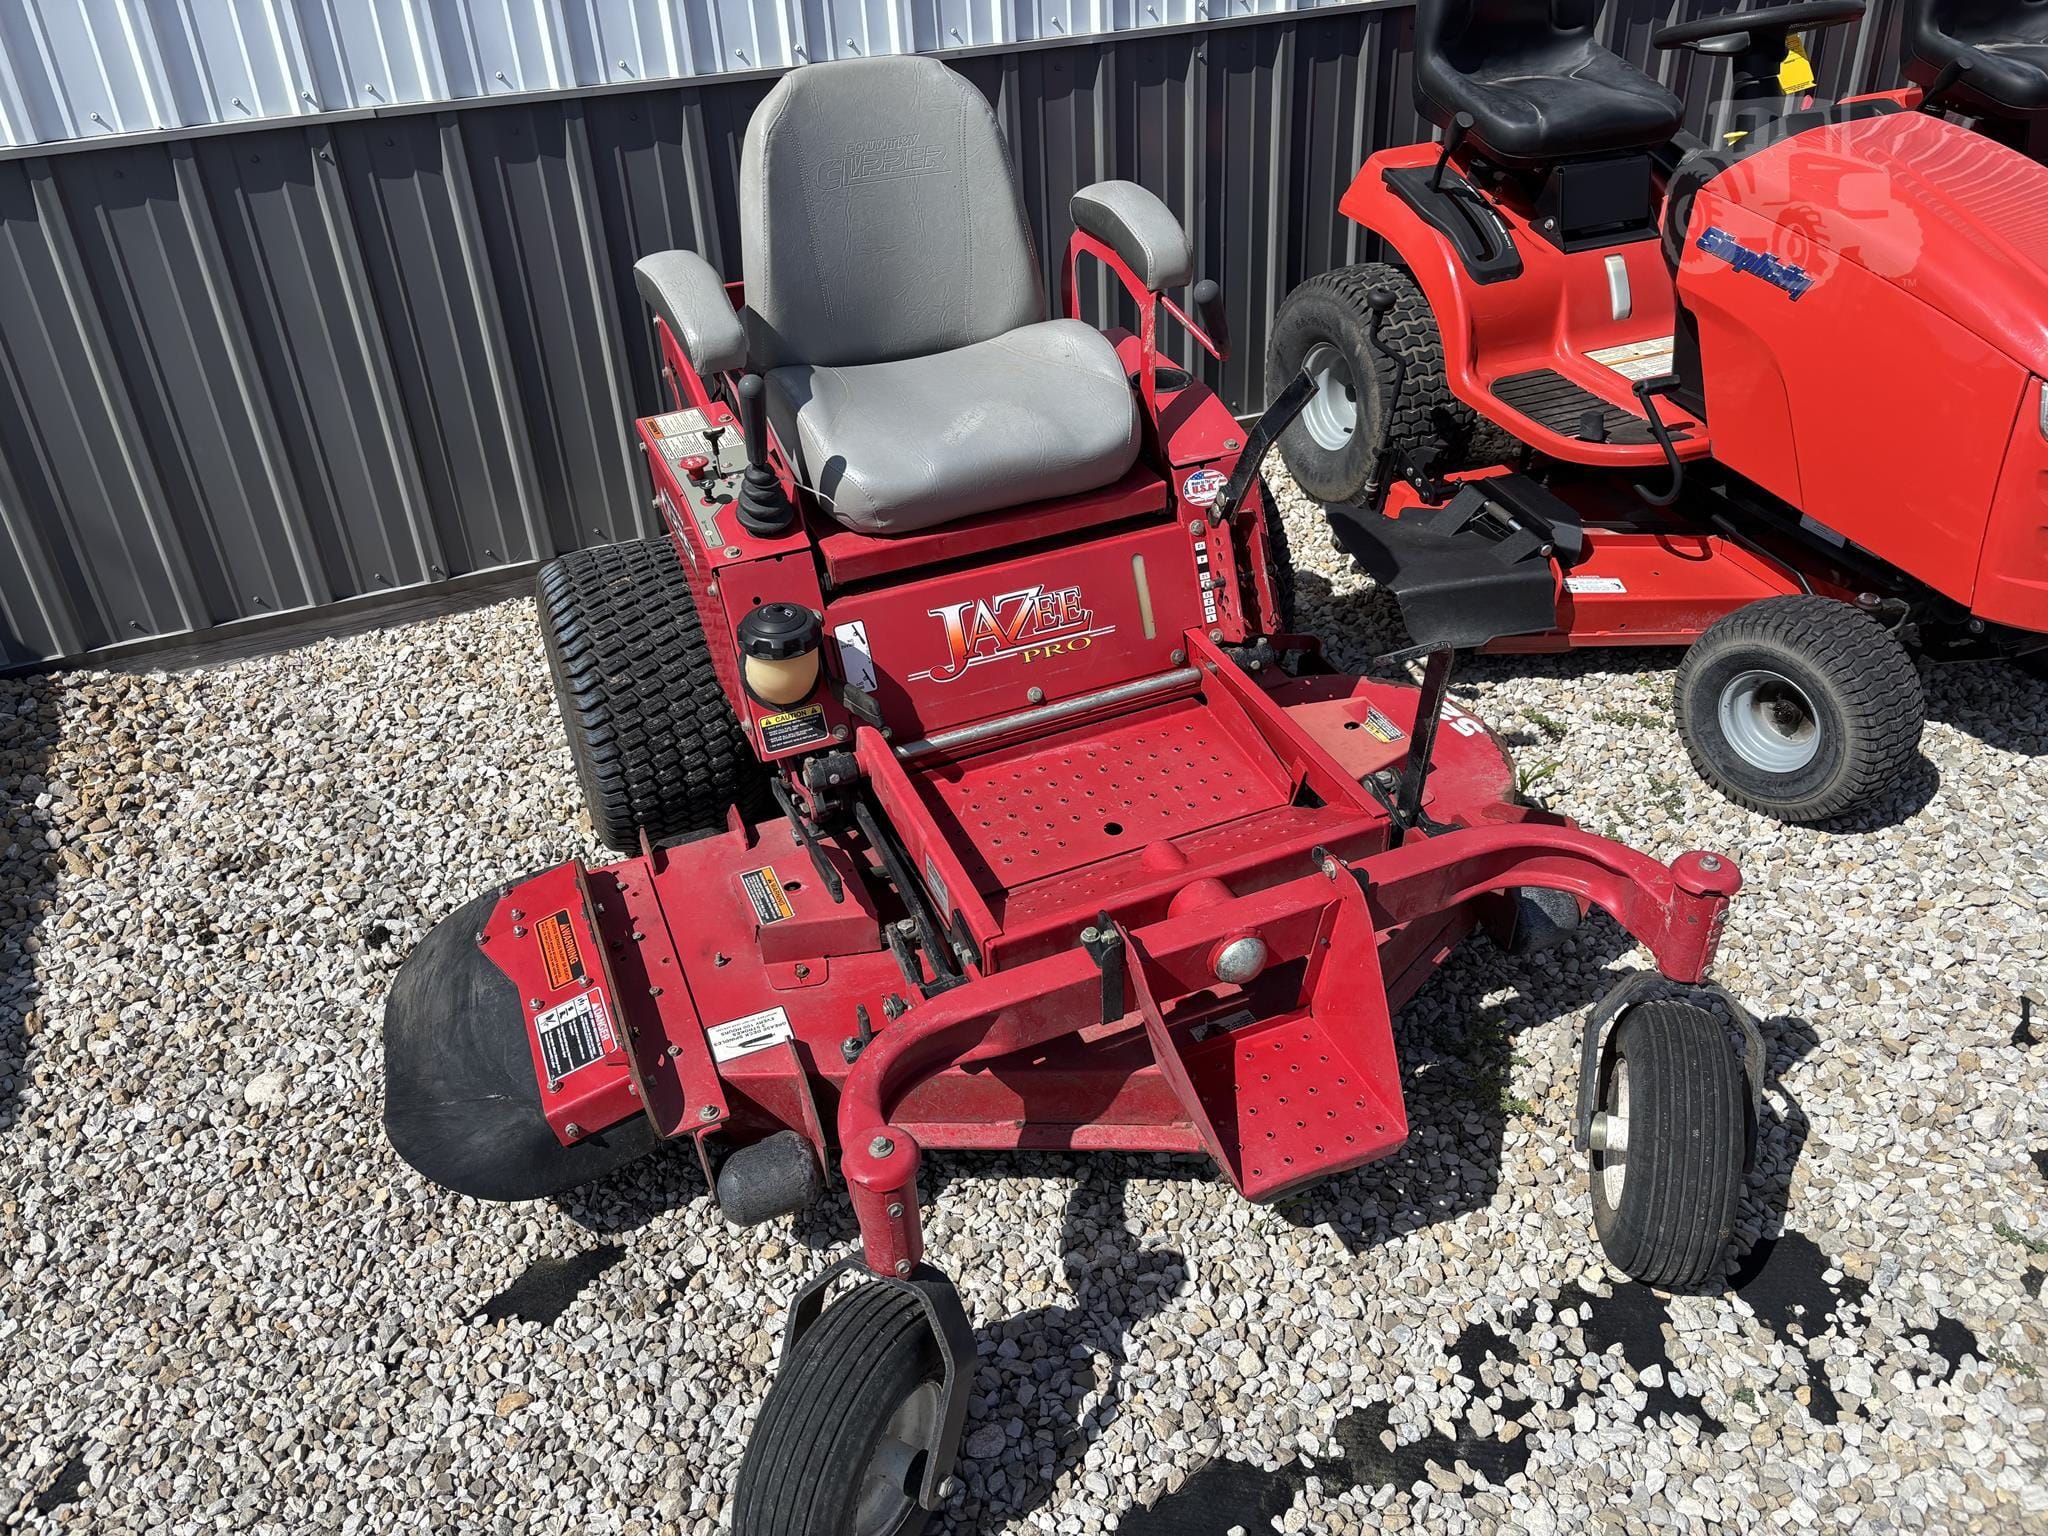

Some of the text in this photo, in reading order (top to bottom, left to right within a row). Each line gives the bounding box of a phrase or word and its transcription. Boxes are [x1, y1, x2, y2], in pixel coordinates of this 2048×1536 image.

[844, 133, 920, 154] COUNTRY
[817, 144, 948, 191] CLIPPER
[1696, 226, 1814, 302] Simplicity
[1192, 482, 1216, 494] U.S.A.
[928, 584, 1092, 682] JAZEE
[1022, 637, 1092, 664] PRO
[775, 710, 807, 723] CAUTION
[771, 884, 785, 906] WARNING
[562, 927, 578, 965] WARNING
[594, 1008, 610, 1041] DANGER
[720, 1027, 742, 1036] HOURS
[755, 1017, 775, 1026] EVERY
[762, 1021, 787, 1032] GREASE
[714, 1035, 743, 1047] SPINDLES
[745, 1029, 762, 1037] DECK
